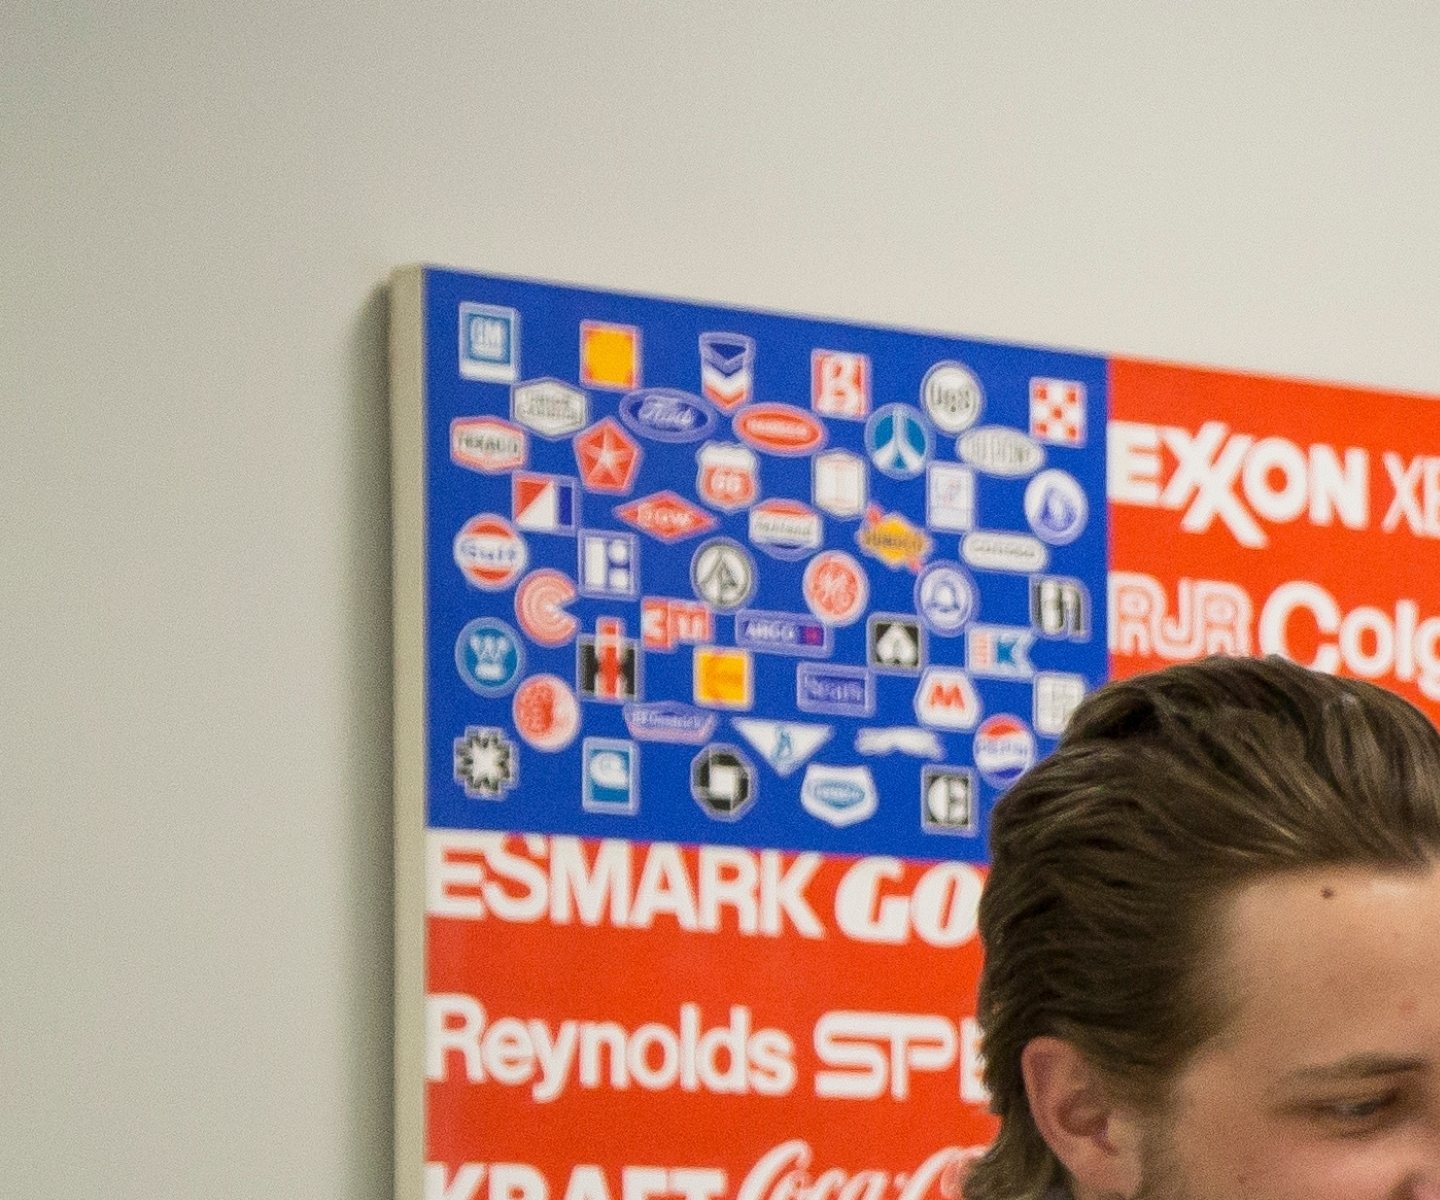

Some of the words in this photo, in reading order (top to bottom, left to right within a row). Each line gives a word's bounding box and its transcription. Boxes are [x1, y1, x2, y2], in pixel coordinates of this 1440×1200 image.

[1108, 420, 1369, 548] EXXON
[1109, 571, 1252, 659] RJR
[426, 832, 826, 938] ESMARK
[835, 855, 983, 948] GO
[426, 992, 797, 1102] Reynolds
[813, 1010, 990, 1104] SPE
